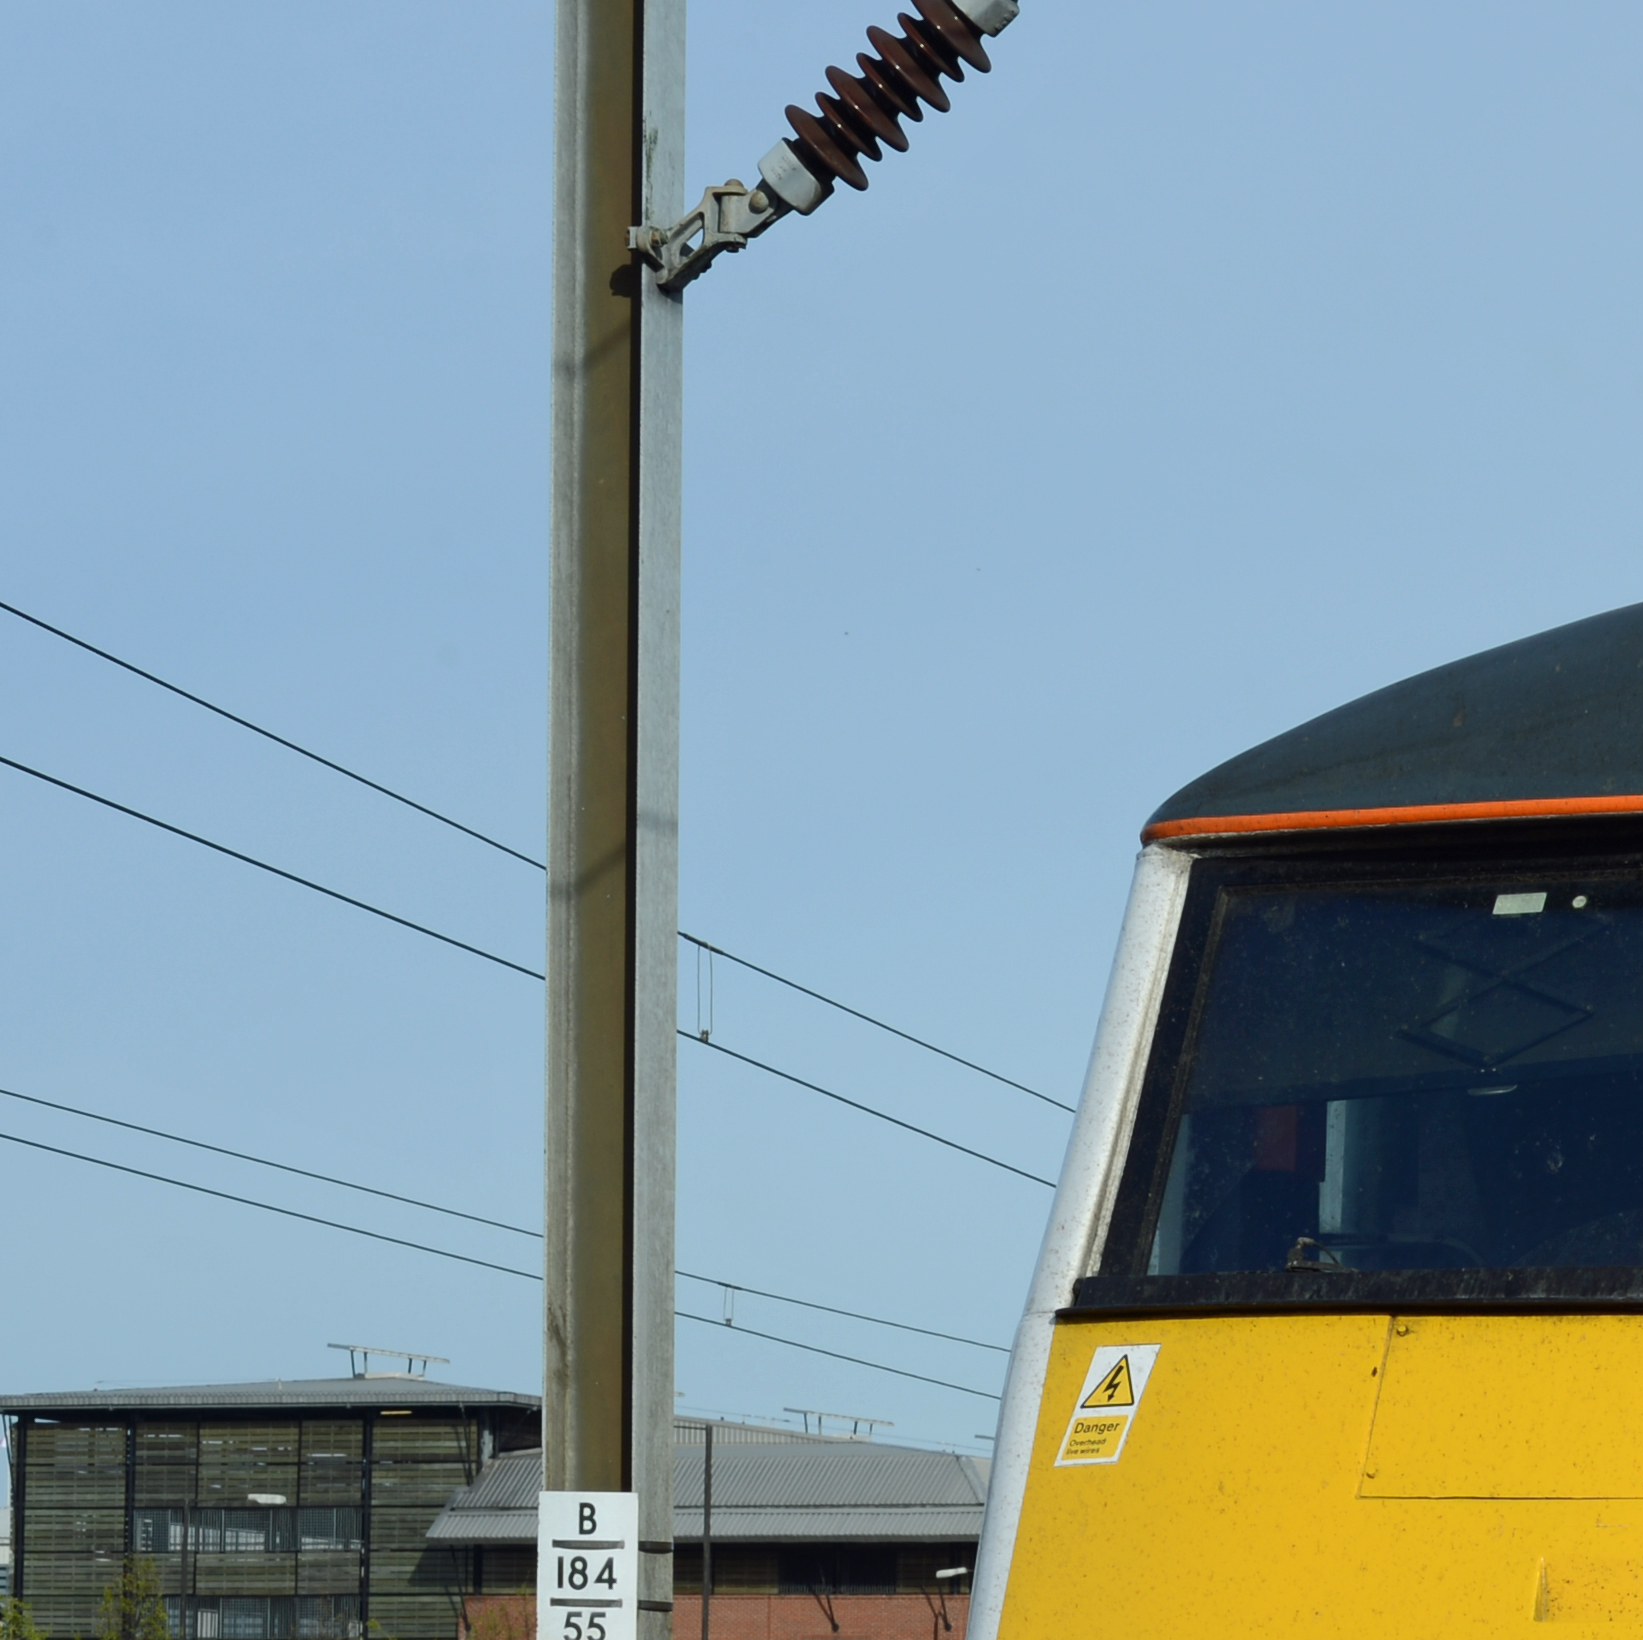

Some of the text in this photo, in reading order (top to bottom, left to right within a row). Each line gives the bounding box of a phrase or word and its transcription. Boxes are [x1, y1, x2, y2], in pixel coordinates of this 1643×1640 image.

[1074, 1422, 1120, 1434] Danger
[1069, 1438, 1107, 1447] Overhead
[578, 1502, 597, 1535] B
[557, 1556, 617, 1590] 184
